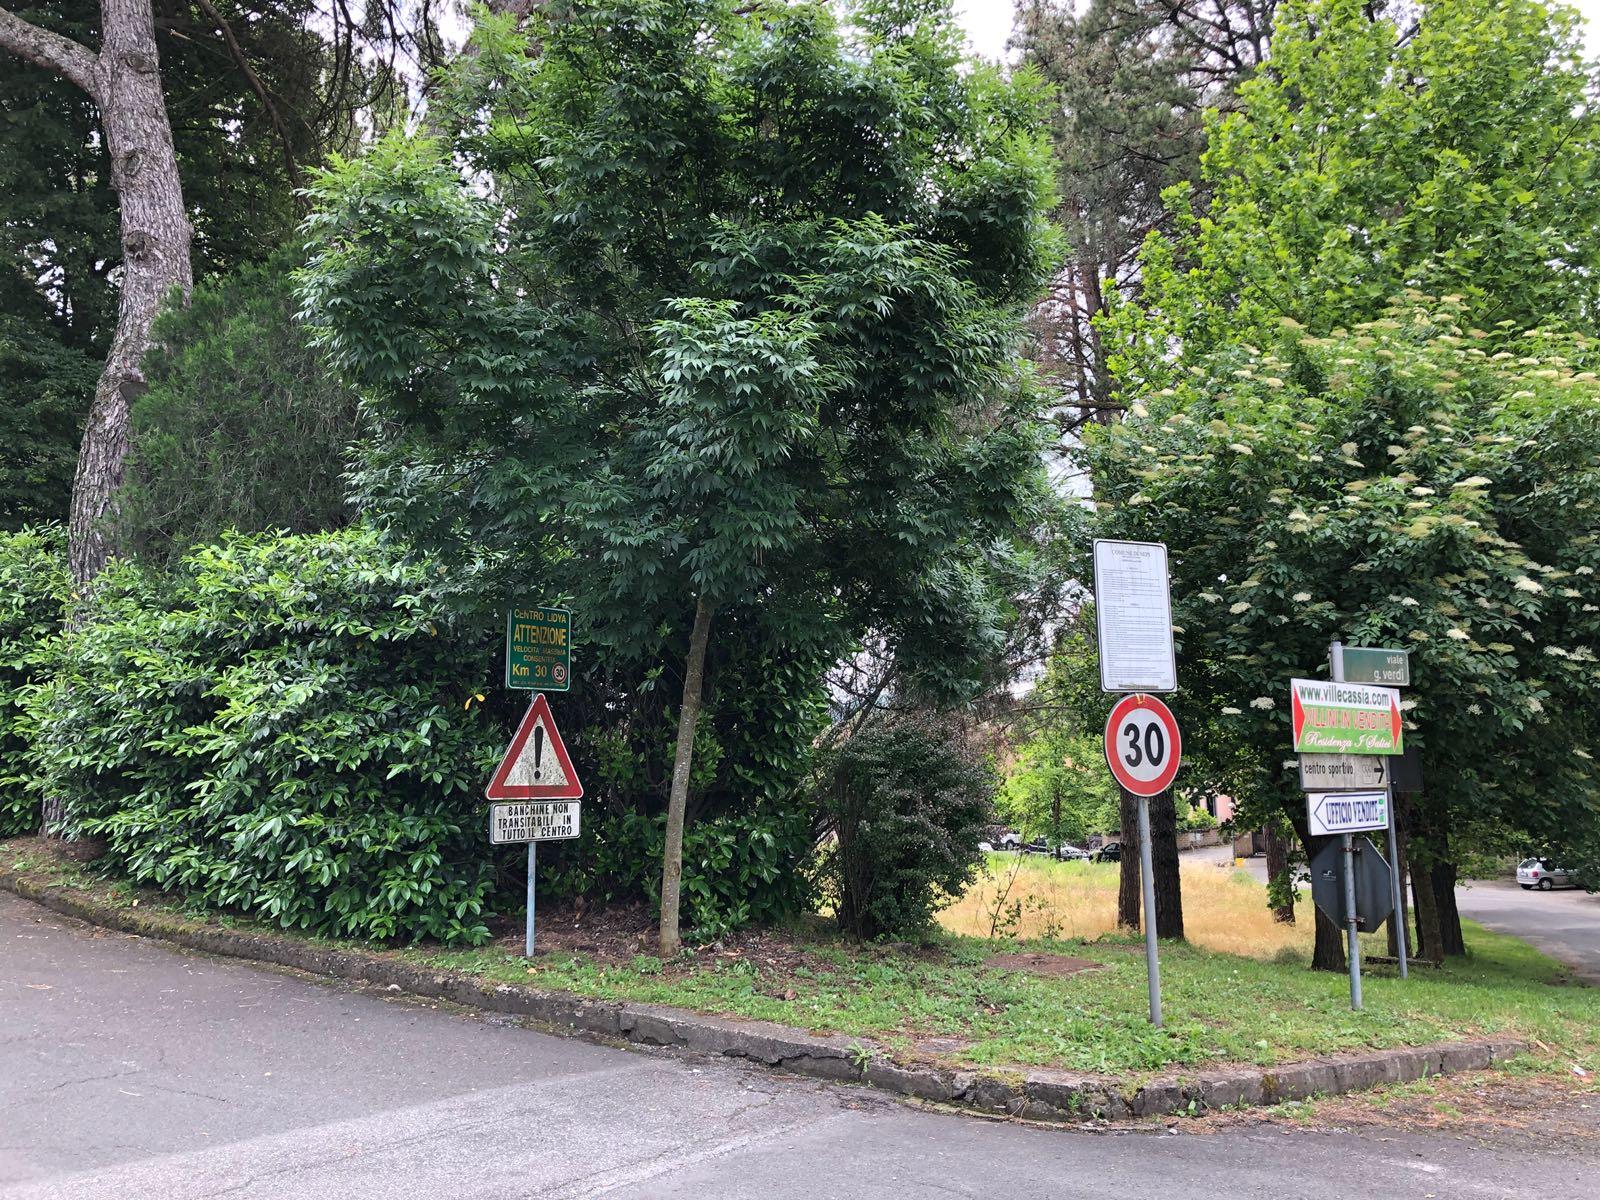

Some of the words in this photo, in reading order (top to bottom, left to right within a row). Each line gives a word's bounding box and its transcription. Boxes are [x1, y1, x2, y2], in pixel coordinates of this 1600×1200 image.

[514, 608, 544, 620] CENTRO
[514, 624, 566, 646] ATTENZIONE
[1386, 655, 1403, 664] viale
[512, 663, 529, 676] Km
[535, 664, 547, 677] 30
[556, 667, 563, 678] 30
[1373, 670, 1381, 681] g.
[1383, 668, 1404, 680] verdi
[1299, 684, 1389, 706] www.villecassia.com
[1304, 706, 1337, 729] VILLINI
[1342, 708, 1350, 729] IN
[1123, 721, 1164, 768] 30
[1304, 731, 1352, 752] Residenza
[1304, 762, 1326, 775] centro
[1328, 762, 1354, 778] sportivo
[508, 804, 549, 816] BANCHINE
[552, 803, 569, 814] NON
[1325, 801, 1352, 825] UFFICIO
[1353, 800, 1378, 823] VENDITE
[498, 815, 554, 829] TRANSITABILI
[563, 815, 571, 825] IN
[503, 828, 525, 840] TUTTO
[528, 827, 535, 838] IL
[541, 825, 572, 837] CENTRO
